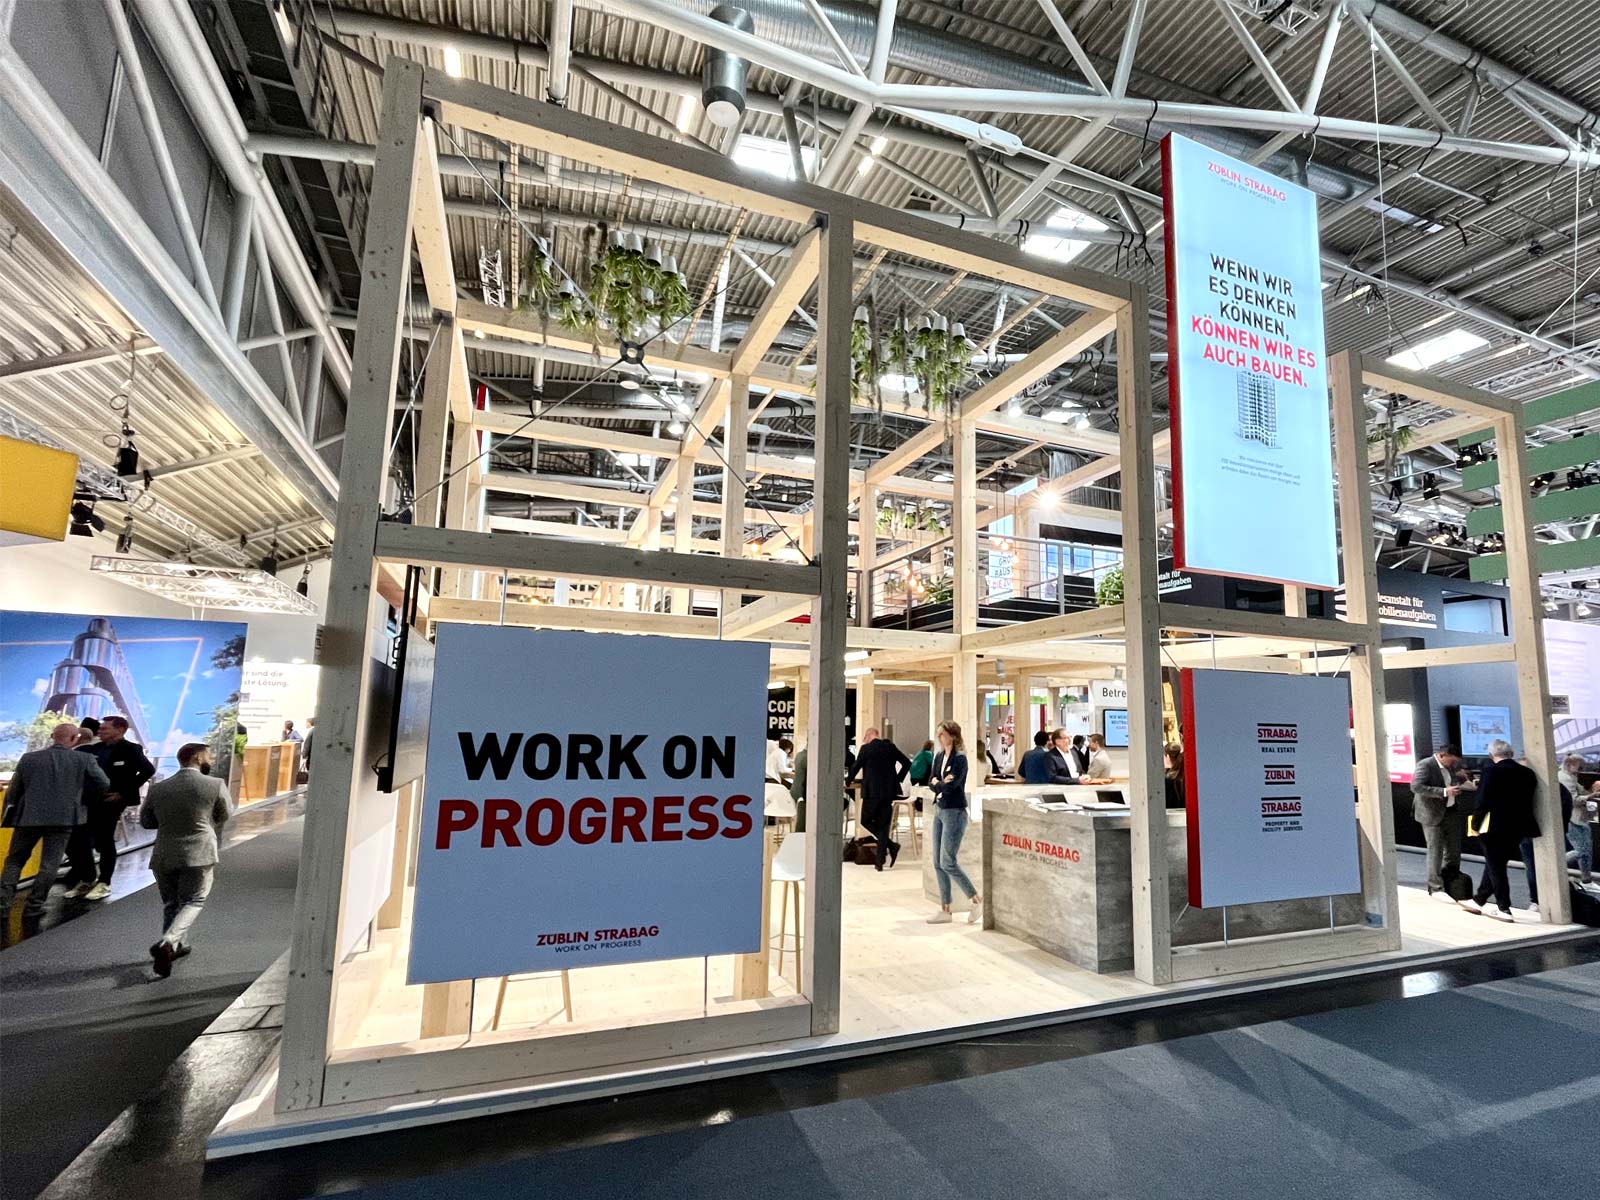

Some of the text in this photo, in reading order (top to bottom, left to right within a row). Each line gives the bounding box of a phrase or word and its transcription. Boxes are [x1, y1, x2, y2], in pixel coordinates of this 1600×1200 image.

[1244, 177, 1286, 201] STRABAG
[1210, 252, 1293, 297] WENN WIR
[1209, 275, 1296, 319] ES DENKEN
[1220, 299, 1289, 341] KÖNNEN,
[1191, 313, 1316, 369] KÖNNEN WIR ES
[1203, 342, 1308, 388] AUCH BAUEN.
[1412, 596, 1424, 608] für
[270, 669, 283, 678] die
[1102, 687, 1127, 698] Betre
[1258, 728, 1297, 739] STRABAG
[458, 731, 737, 781] WORK ON
[1261, 801, 1301, 813] STRABAG
[435, 794, 753, 850] PROGRESS
[1035, 841, 1080, 863] STRABAG
[594, 925, 660, 941] STRABAG
[555, 939, 642, 953] WORK ON PROGRESS
